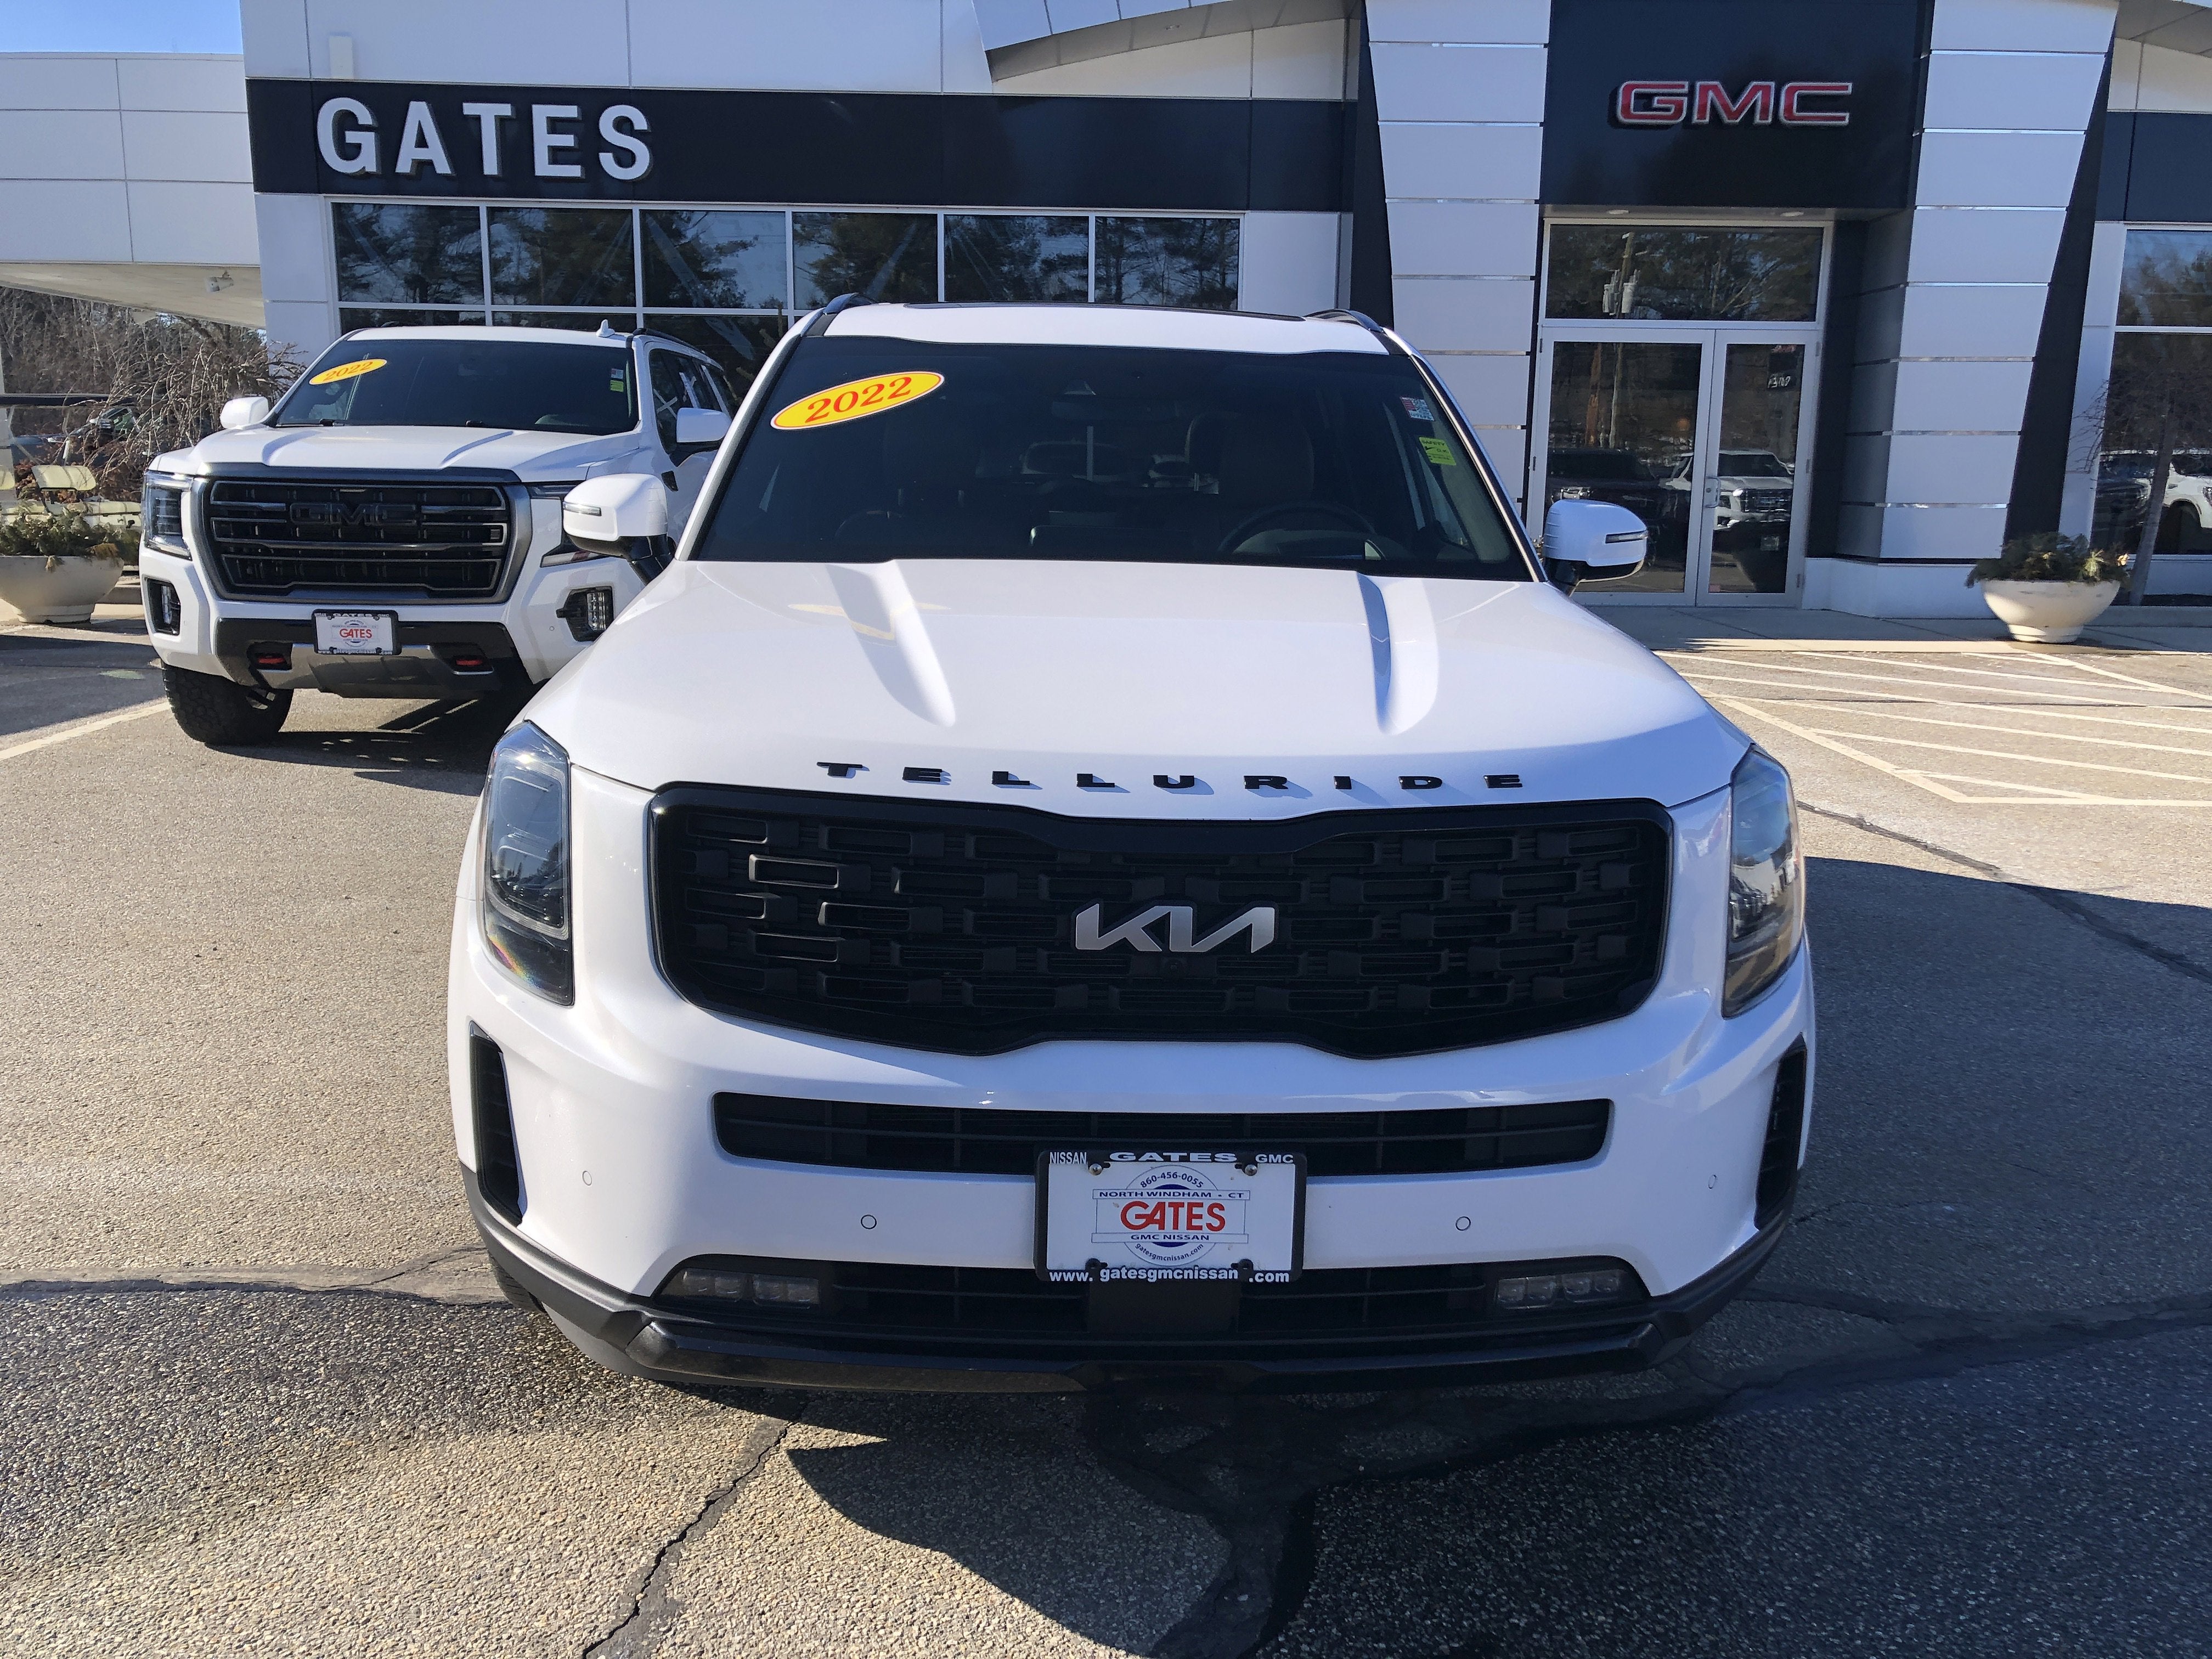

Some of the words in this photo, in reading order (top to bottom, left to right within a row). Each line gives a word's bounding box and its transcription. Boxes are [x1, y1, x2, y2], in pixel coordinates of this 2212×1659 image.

[1616, 80, 1853, 126] GMC
[317, 97, 651, 180] GATES
[323, 361, 374, 381] 2022
[804, 377, 912, 424] 2022
[290, 503, 417, 525] GMC
[339, 628, 373, 638] GATES
[817, 761, 1524, 790] TELLURIDE
[1075, 904, 1276, 953] KIA
[1049, 1152, 1087, 1164] NISSAN
[1109, 1152, 1237, 1162] GATES
[1255, 1154, 1294, 1164] GMC
[1140, 1171, 1204, 1188] 860-456-0055
[1120, 1201, 1226, 1232] GATES
[1135, 1243, 1205, 1261] gatesgmcnissan.com
[1049, 1272, 1093, 1282] www.
[1100, 1266, 1239, 1283] gatesgmcnissan
[1249, 1272, 1290, 1283] .com
